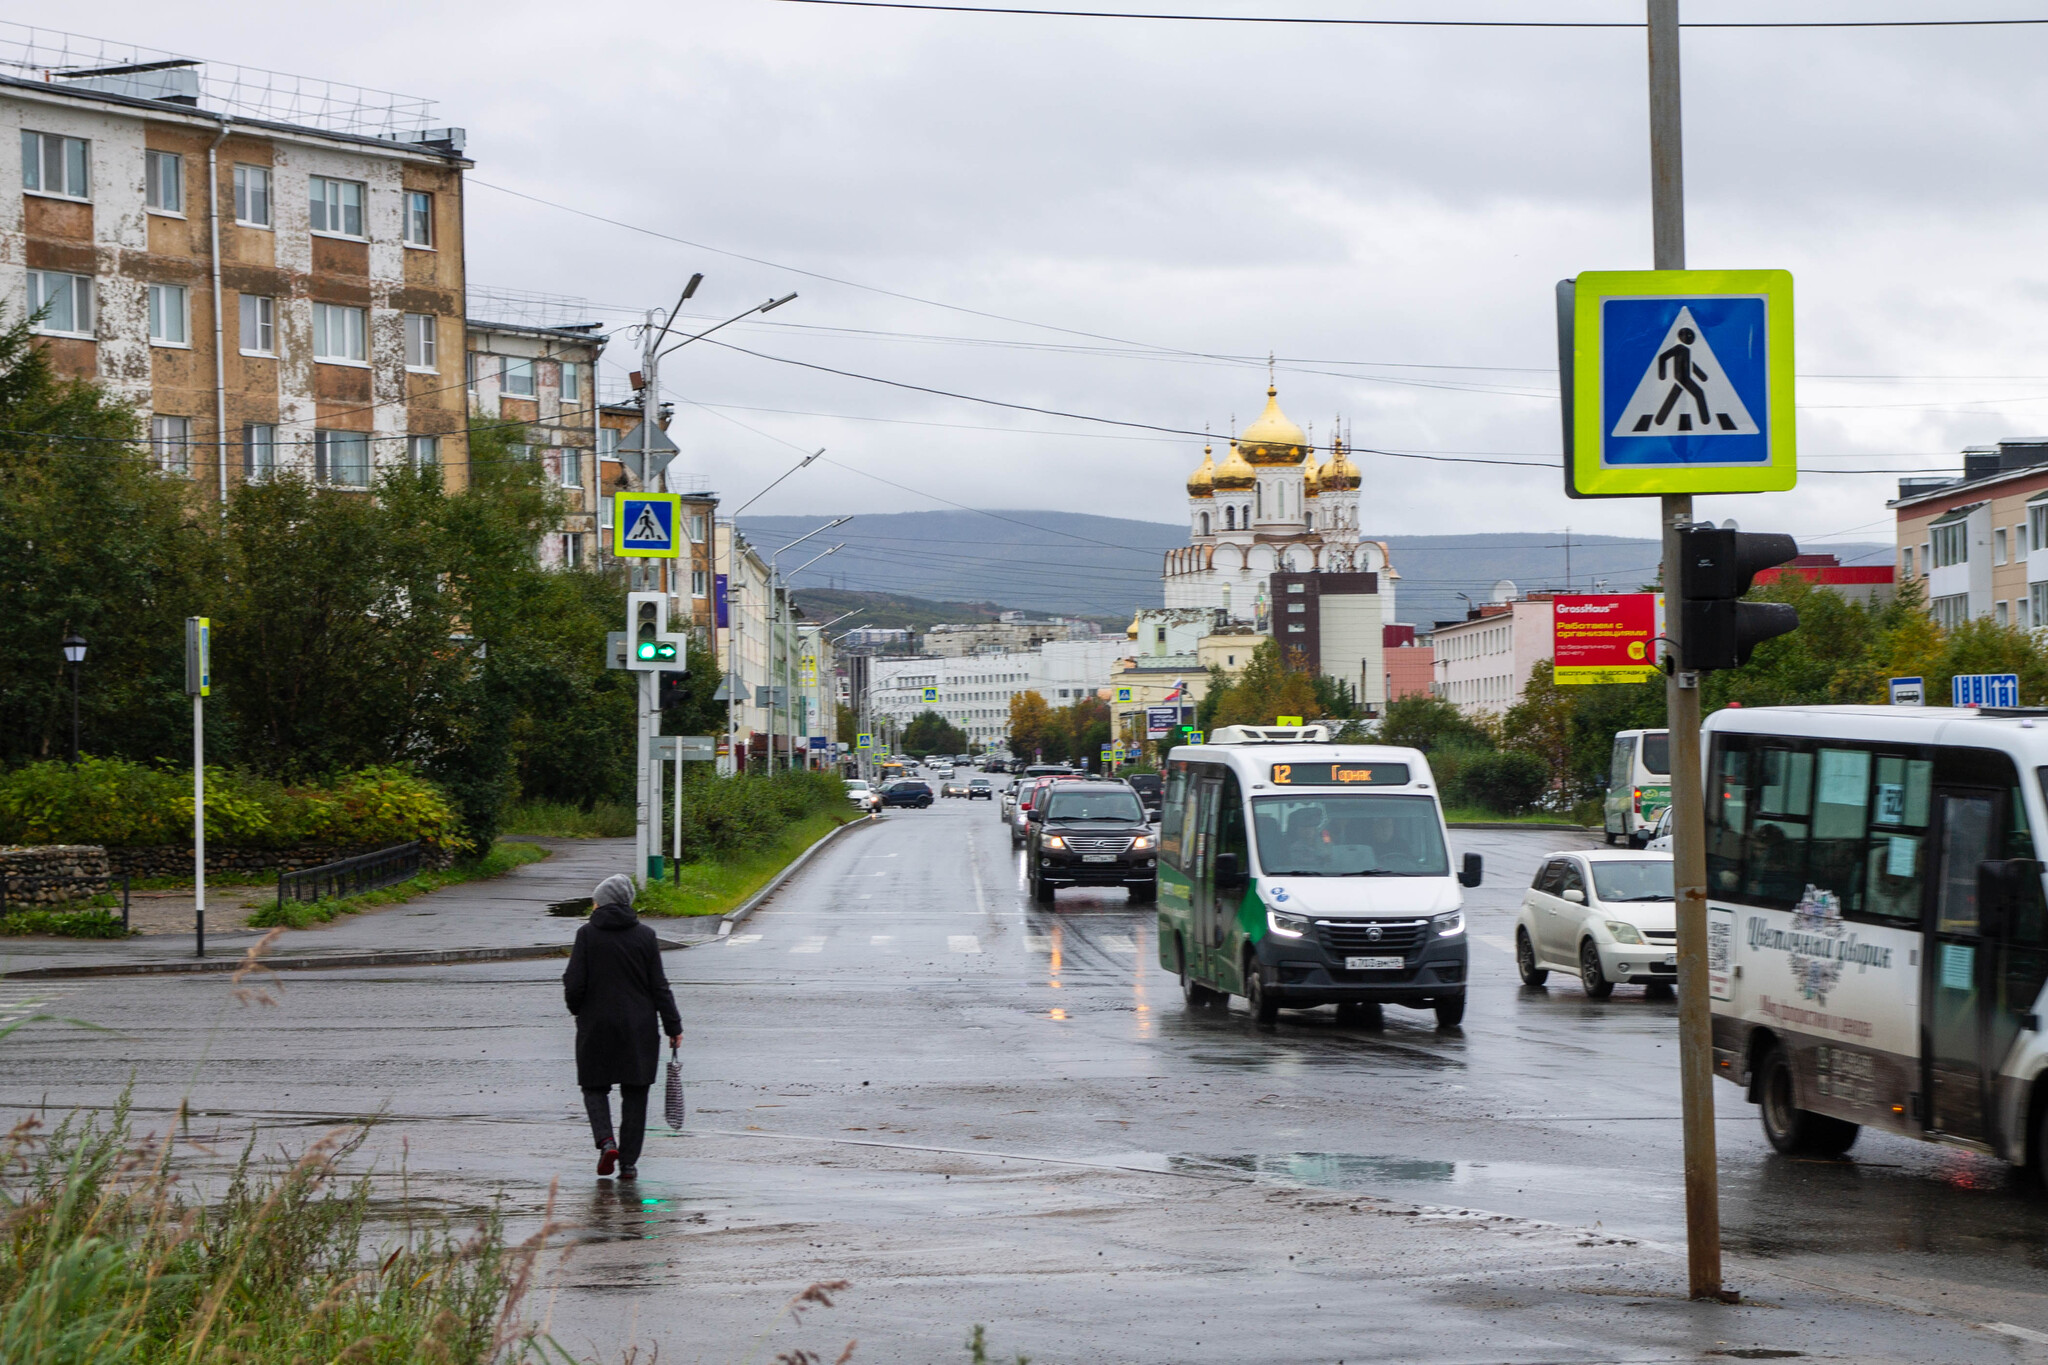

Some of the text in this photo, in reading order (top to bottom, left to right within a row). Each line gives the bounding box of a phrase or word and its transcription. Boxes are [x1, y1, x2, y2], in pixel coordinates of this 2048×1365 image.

[1556, 603, 1610, 614] GrossHaus
[1556, 621, 1614, 629] Работаем
[1556, 630, 1647, 638] организациями
[1273, 764, 1291, 784] 12
